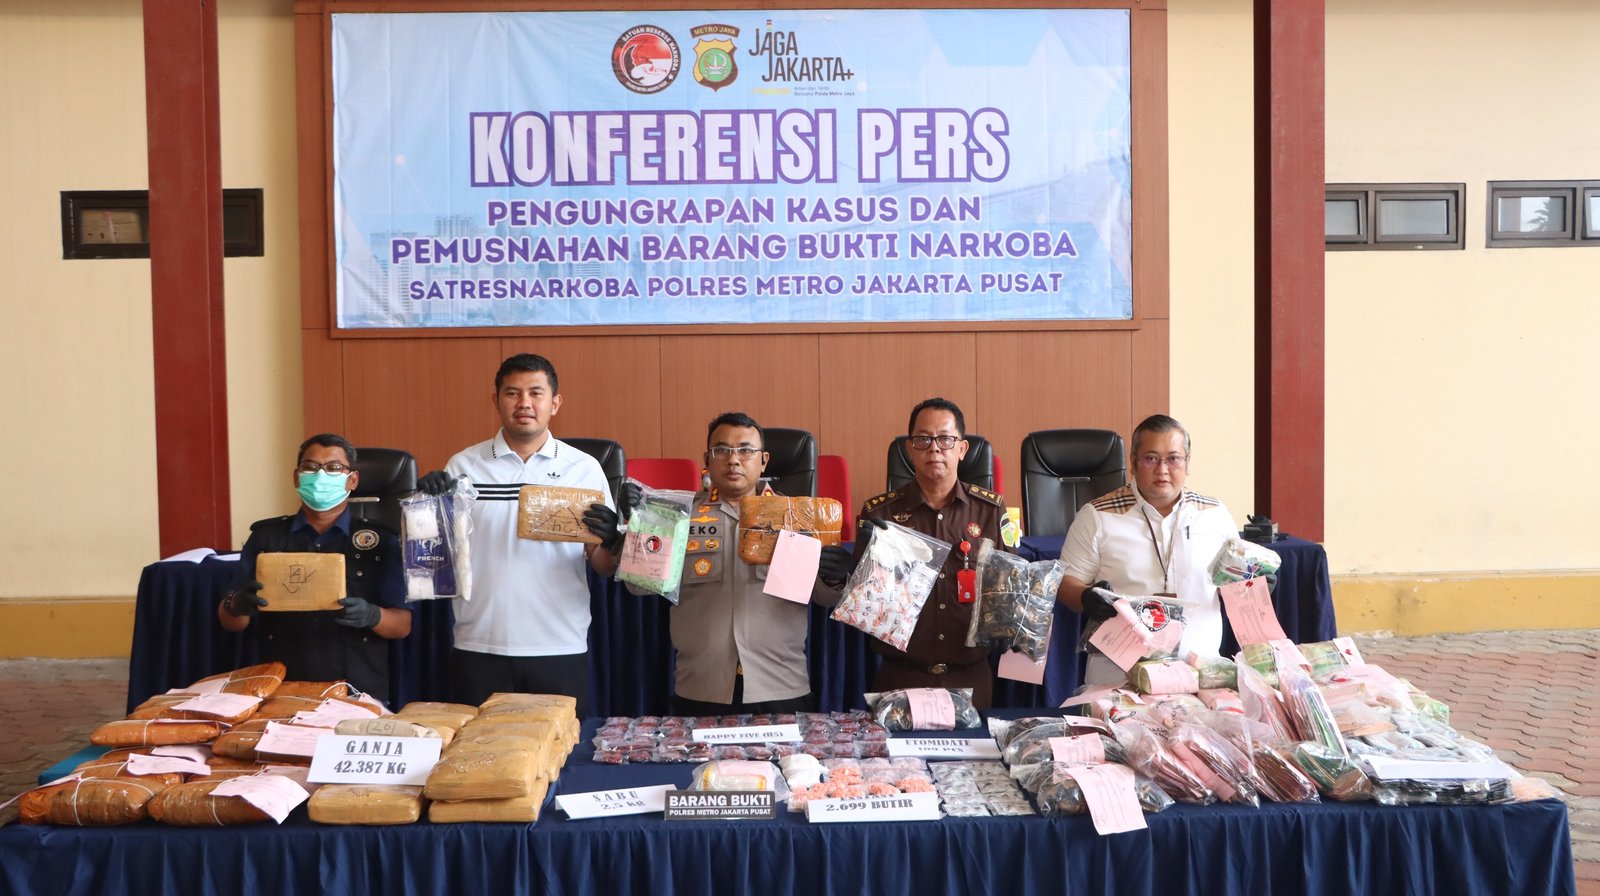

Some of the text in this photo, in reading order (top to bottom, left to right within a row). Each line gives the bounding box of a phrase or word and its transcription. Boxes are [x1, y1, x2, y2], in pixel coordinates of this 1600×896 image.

[622, 27, 645, 42] SATUAN
[694, 26, 736, 35] METRO JAYA
[748, 28, 799, 57] JAGA
[470, 107, 1010, 187] KONFERENSI PERS
[487, 196, 981, 227] PENGUNGKAPAN KASUS DAN
[391, 231, 1078, 265] PEMUSNAHAN BARANG BUKTI NARKOBA
[410, 272, 1063, 301] SATRESNARKOBA POLRES METRO JAKARTA PUSAT
[689, 525, 717, 535] EKO
[371, 719, 392, 732] 26
[703, 731, 736, 740] HAPPY
[739, 731, 760, 739] FIVE
[345, 740, 404, 756] GANJA
[905, 739, 972, 747] ETOMIDATE
[333, 760, 407, 775] 42.387 KG
[592, 790, 639, 802] SABU
[669, 794, 771, 807] BARANG BUKTI
[669, 807, 772, 816] POLRES METRO JAKARTA PUSAT
[825, 798, 914, 812] 2.699 BUTIR
